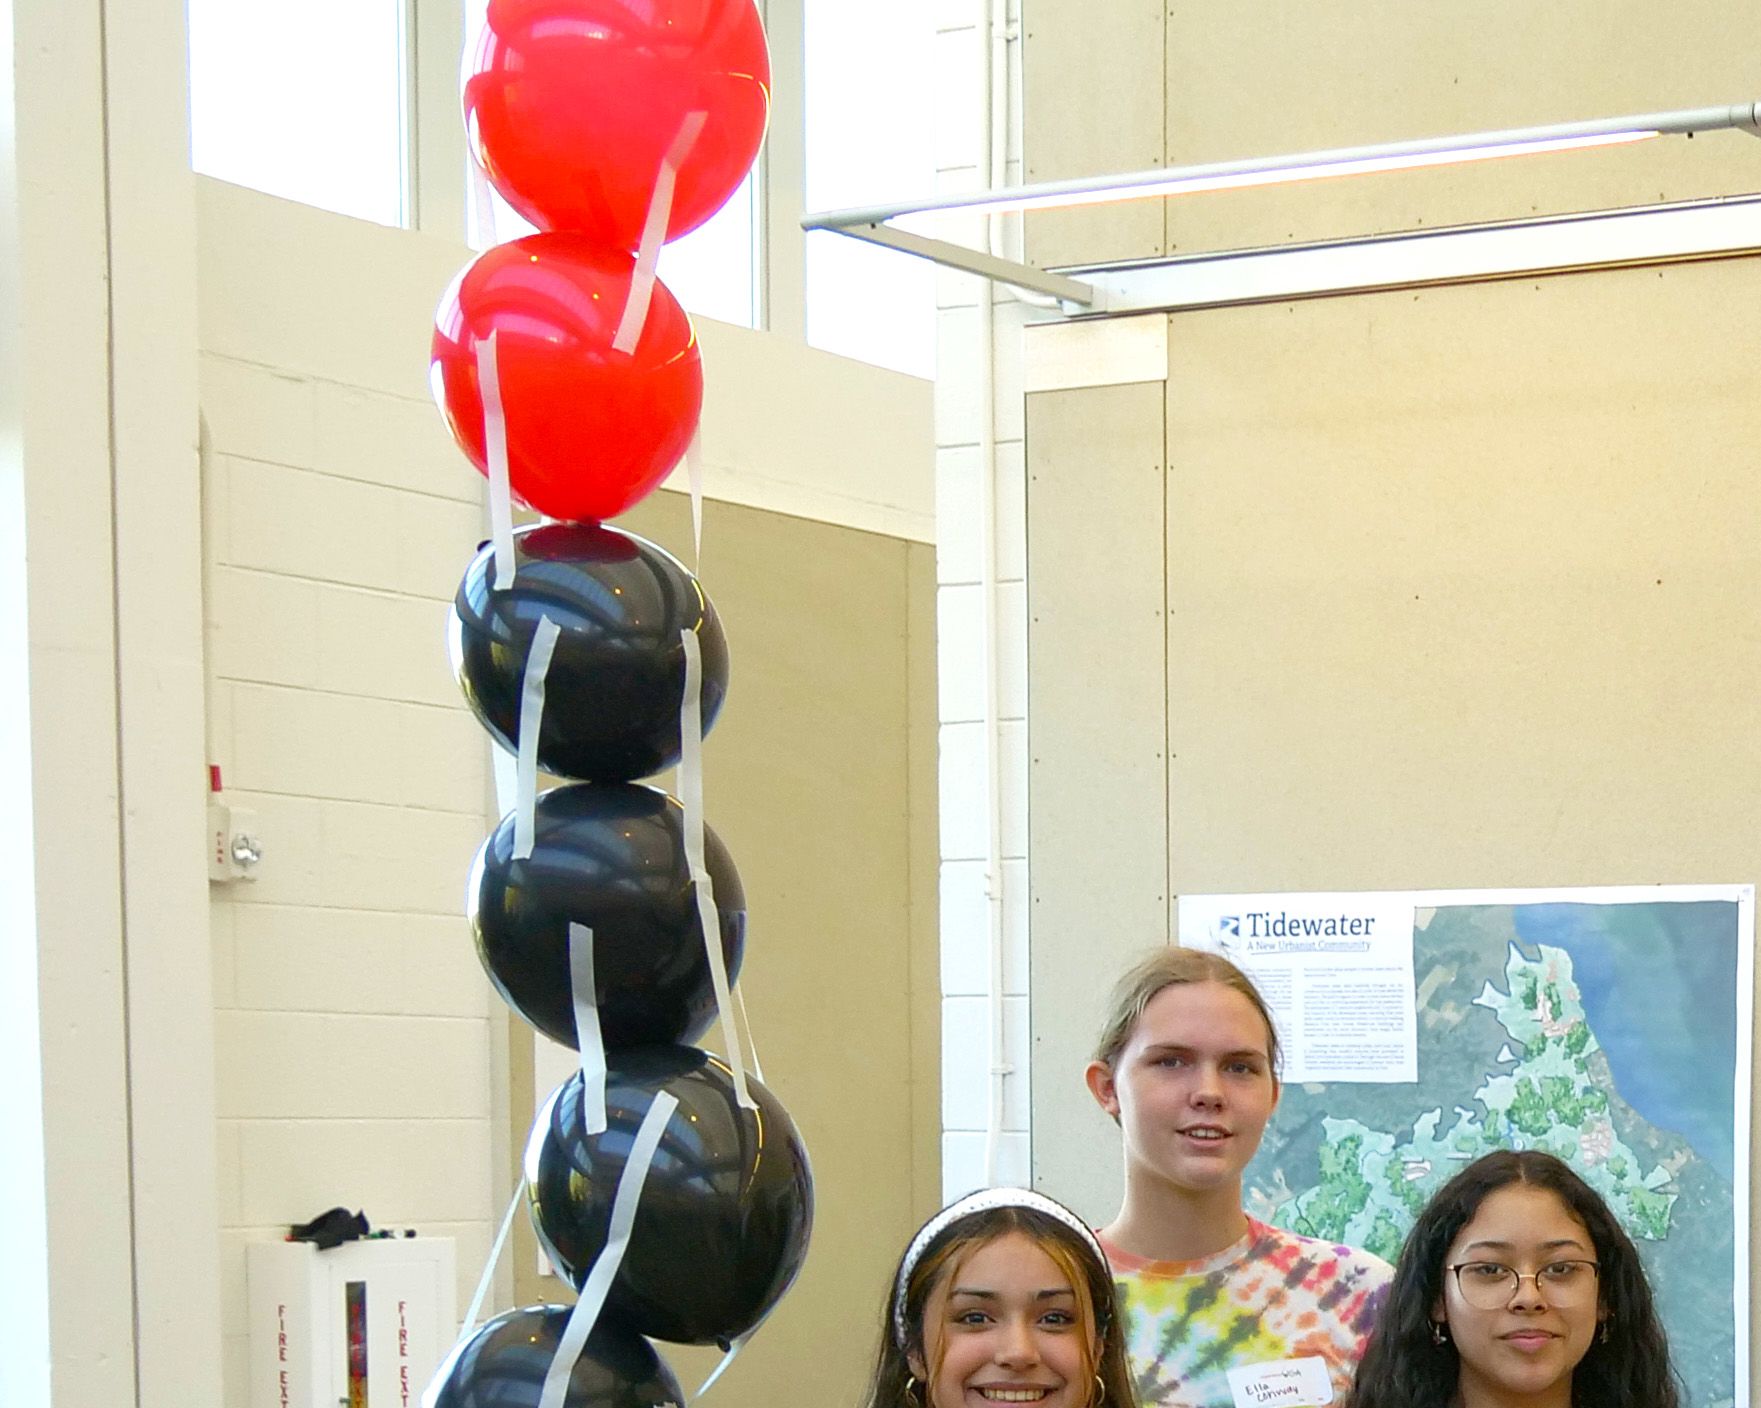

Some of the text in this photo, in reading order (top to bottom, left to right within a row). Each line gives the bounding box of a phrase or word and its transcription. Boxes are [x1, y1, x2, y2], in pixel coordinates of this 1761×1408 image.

[1246, 911, 1376, 938] Tidewater
[1246, 940, 1371, 952] A New Urbanist Community
[278, 1304, 288, 1362] FIRE
[399, 1300, 408, 1357] FIRE
[1244, 1383, 1269, 1396] Ella
